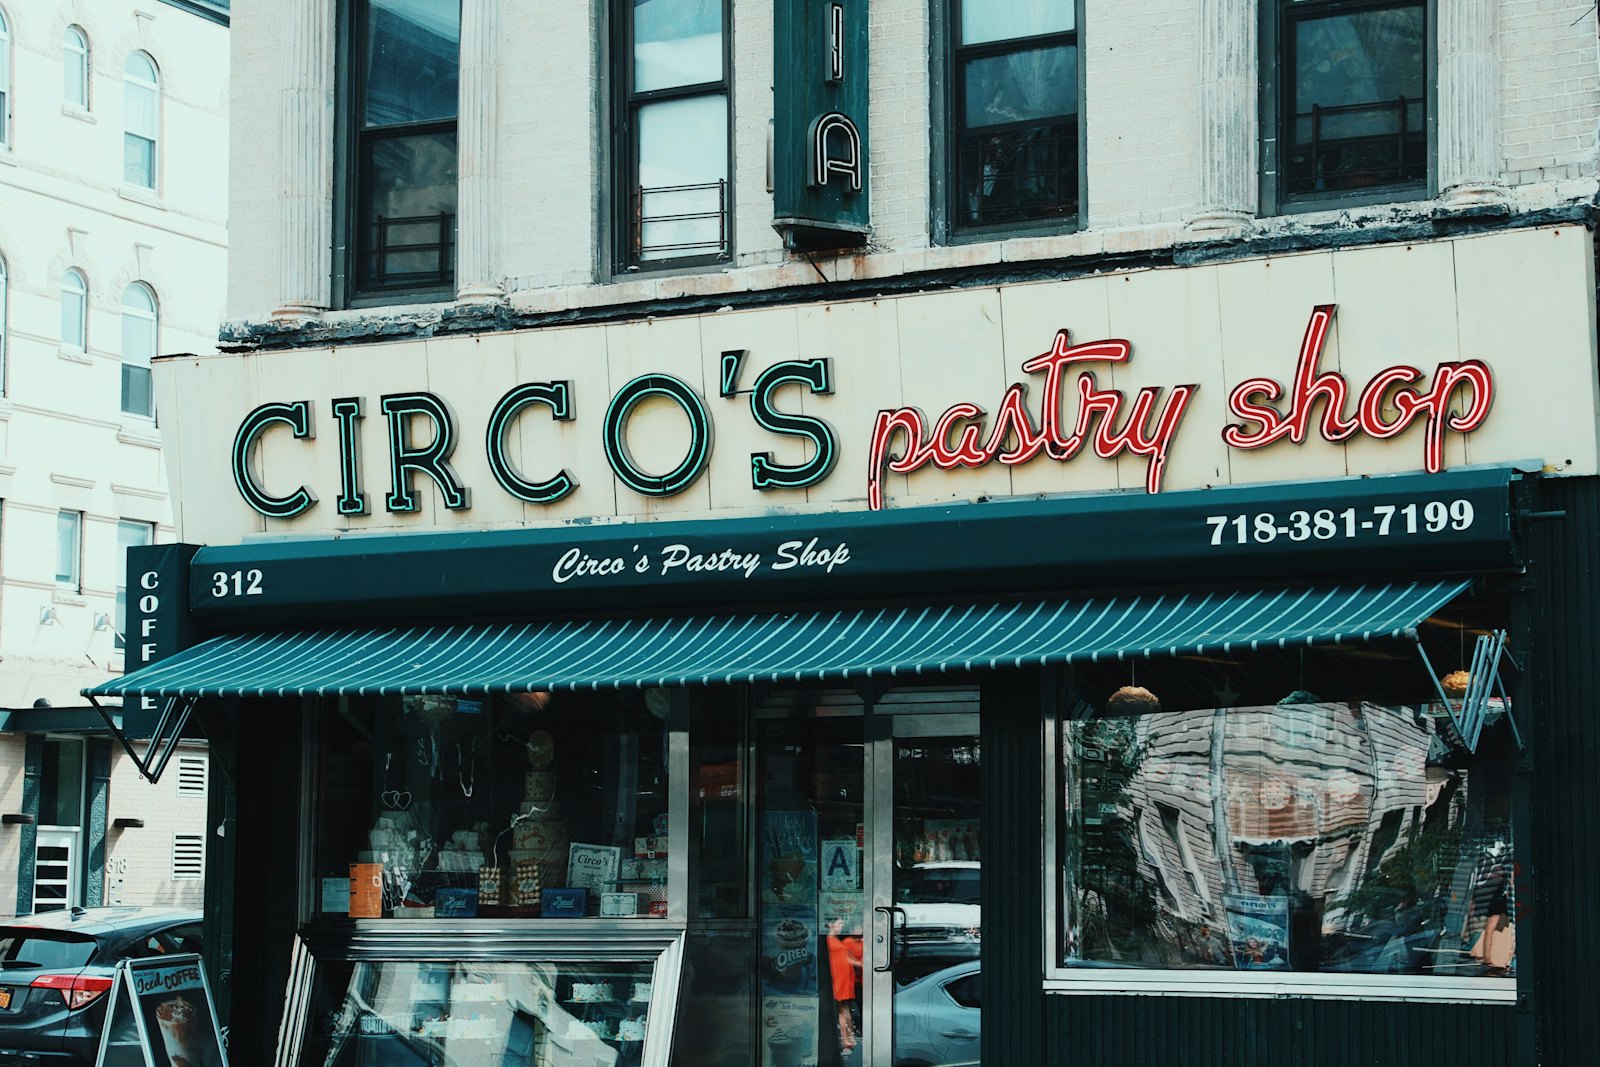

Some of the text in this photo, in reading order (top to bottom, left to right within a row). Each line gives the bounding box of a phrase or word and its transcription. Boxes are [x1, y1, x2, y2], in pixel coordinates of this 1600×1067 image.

[232, 303, 1494, 519] CIRCO'S pastry shop
[1206, 499, 1475, 546] 718-381-7199
[552, 537, 850, 583] Circo's Pastry Shop
[212, 569, 263, 597] 312
[140, 571, 159, 710] COFFE
[106, 858, 127, 874] 318
[577, 854, 610, 867] Circo's
[827, 847, 850, 876] A
[776, 948, 807, 971] OREO
[137, 968, 200, 993] Iced COFFEE
